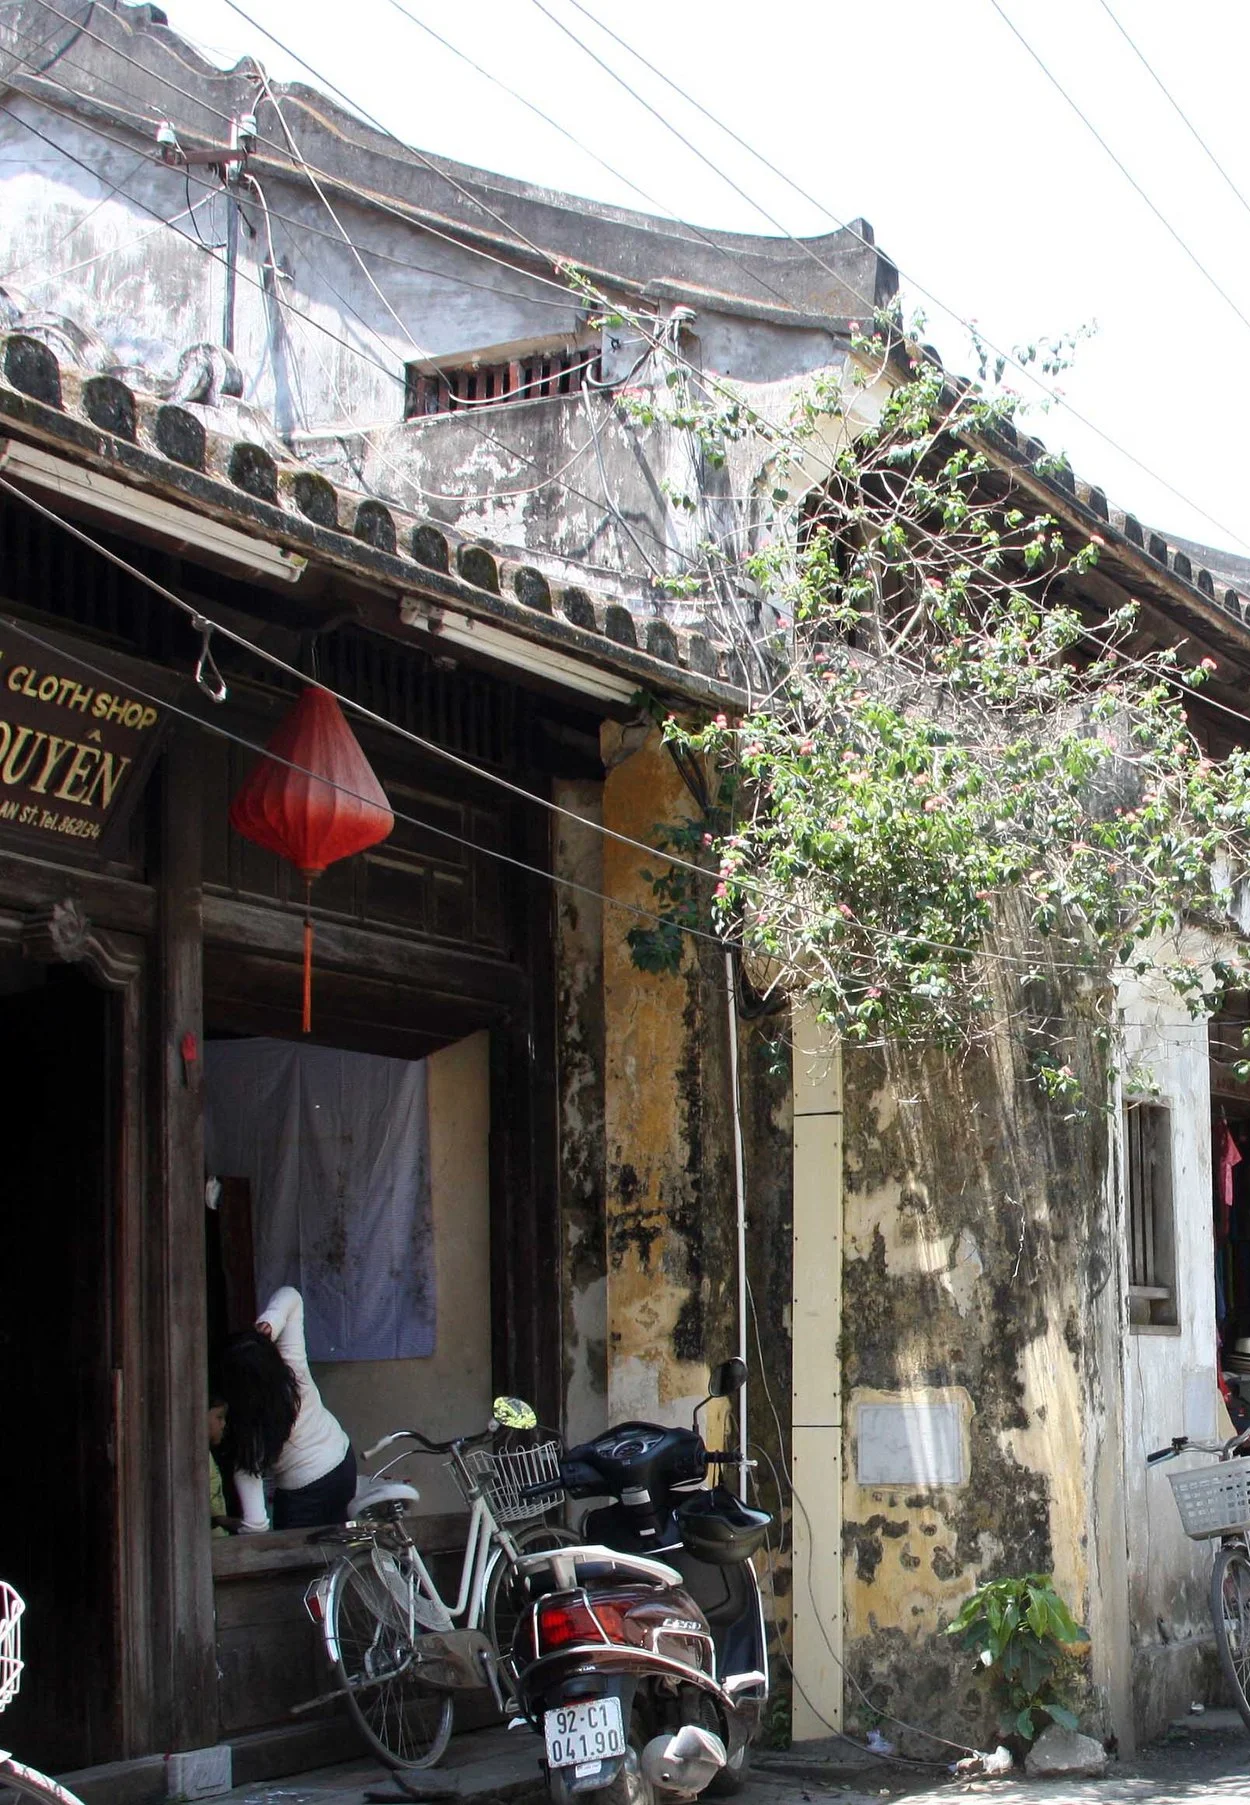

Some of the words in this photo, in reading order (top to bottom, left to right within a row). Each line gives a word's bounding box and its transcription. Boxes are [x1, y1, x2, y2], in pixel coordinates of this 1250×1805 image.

[8, 666, 94, 713] CLOTH
[91, 692, 158, 731] SHOP
[552, 1729, 619, 1763] 041.90
